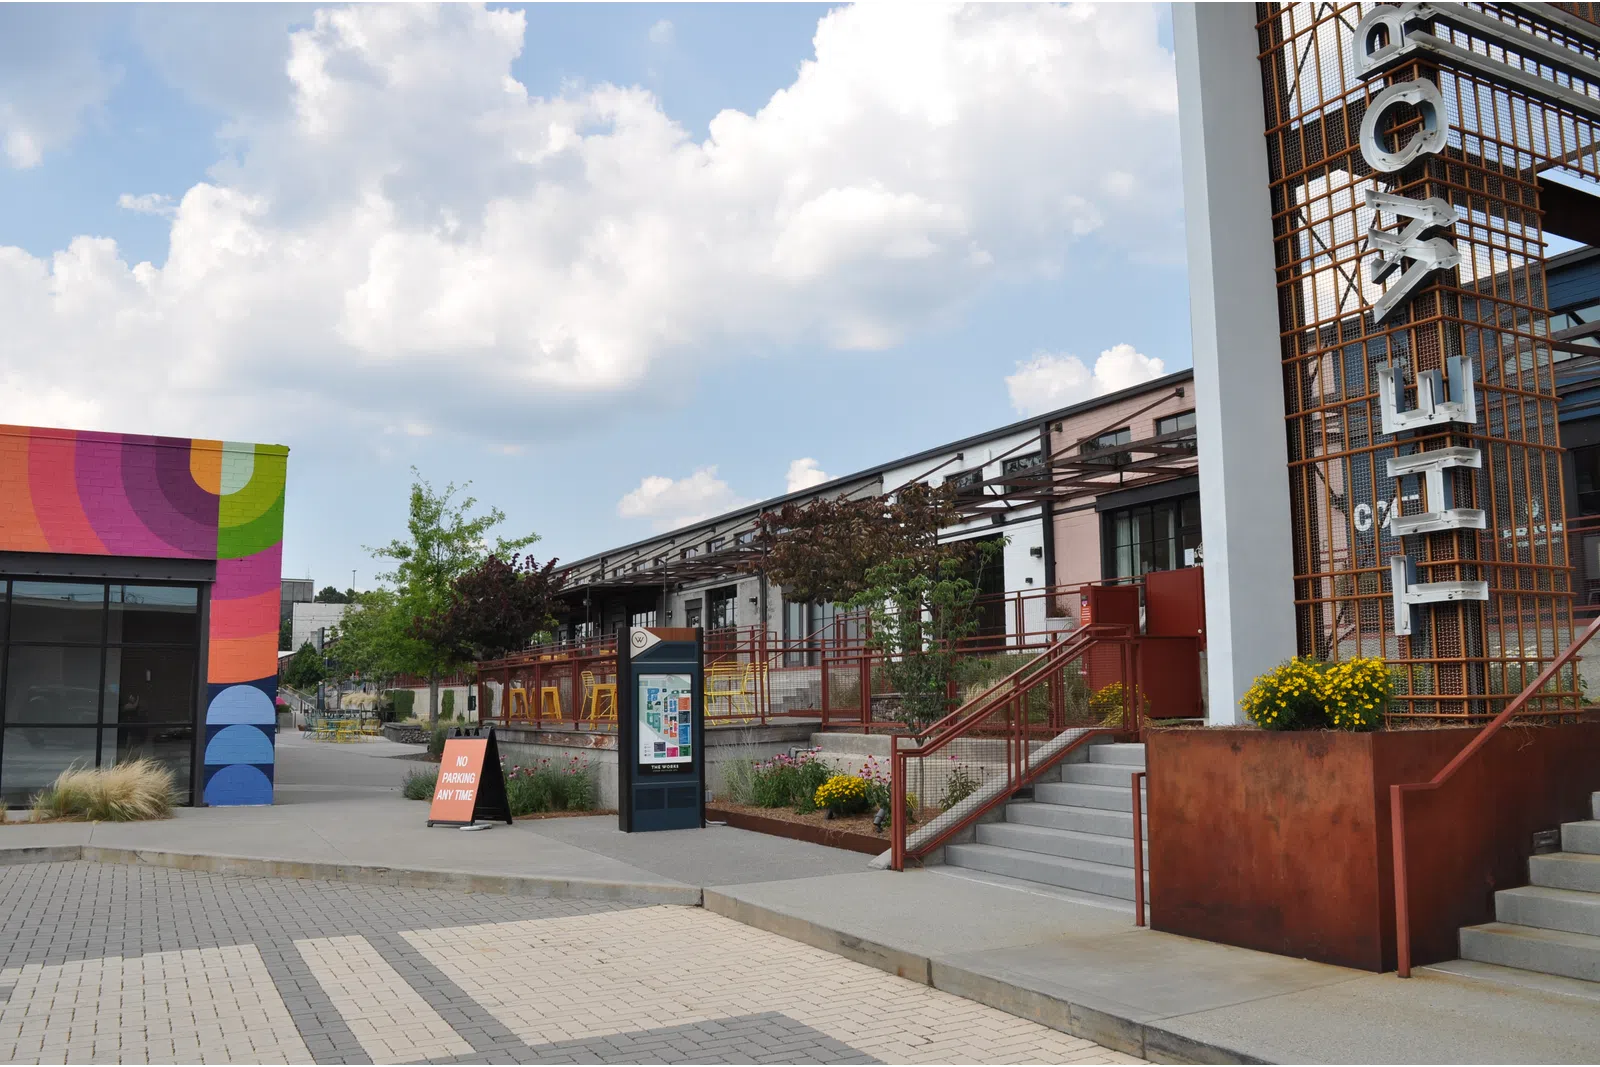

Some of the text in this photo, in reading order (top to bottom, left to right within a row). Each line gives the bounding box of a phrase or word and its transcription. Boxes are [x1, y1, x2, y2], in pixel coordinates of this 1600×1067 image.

[456, 755, 469, 767] NO
[441, 772, 476, 784] PARKING
[436, 789, 474, 801] ANY TIME
